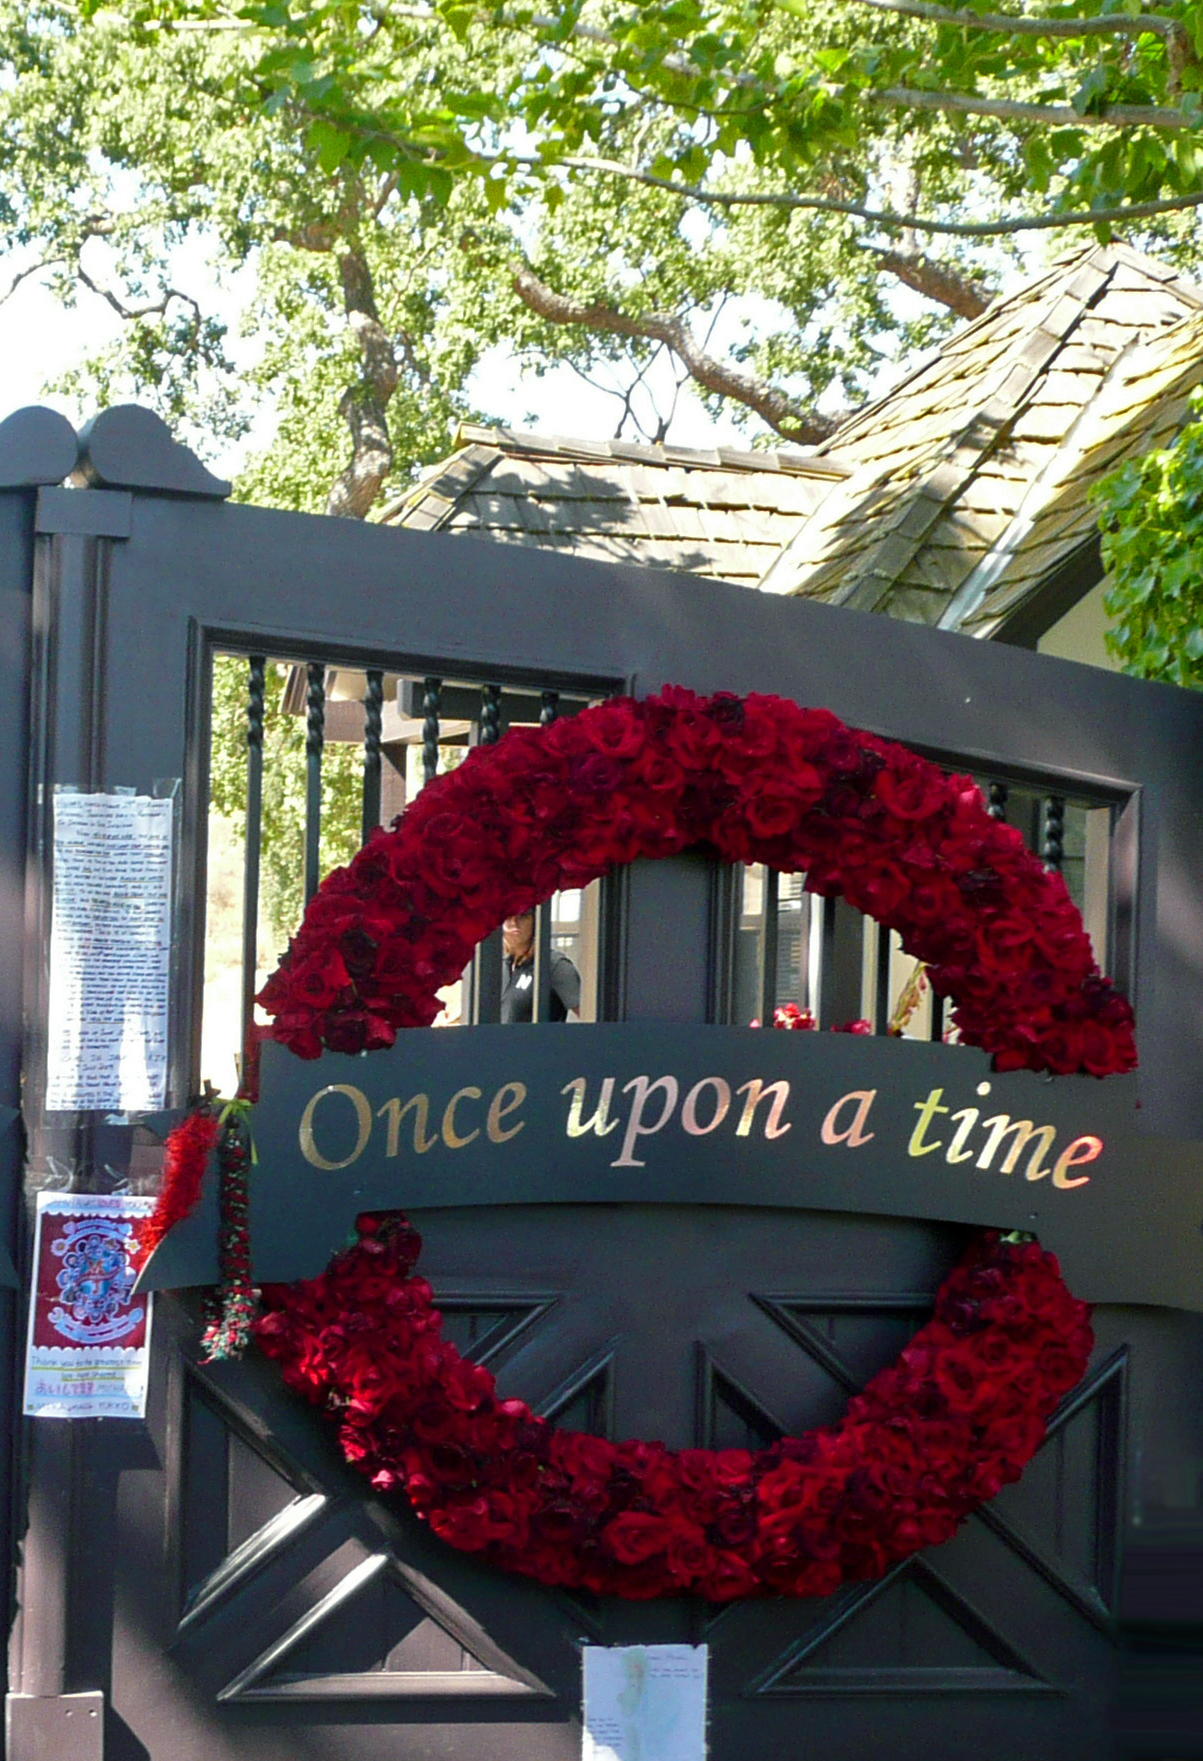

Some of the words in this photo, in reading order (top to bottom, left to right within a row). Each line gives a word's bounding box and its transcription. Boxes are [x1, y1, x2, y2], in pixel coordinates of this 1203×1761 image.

[515, 973, 533, 990] N
[299, 1081, 528, 1171] Once
[560, 1074, 791, 1168] upon
[820, 1088, 875, 1147] a
[907, 1082, 1104, 1190] time
